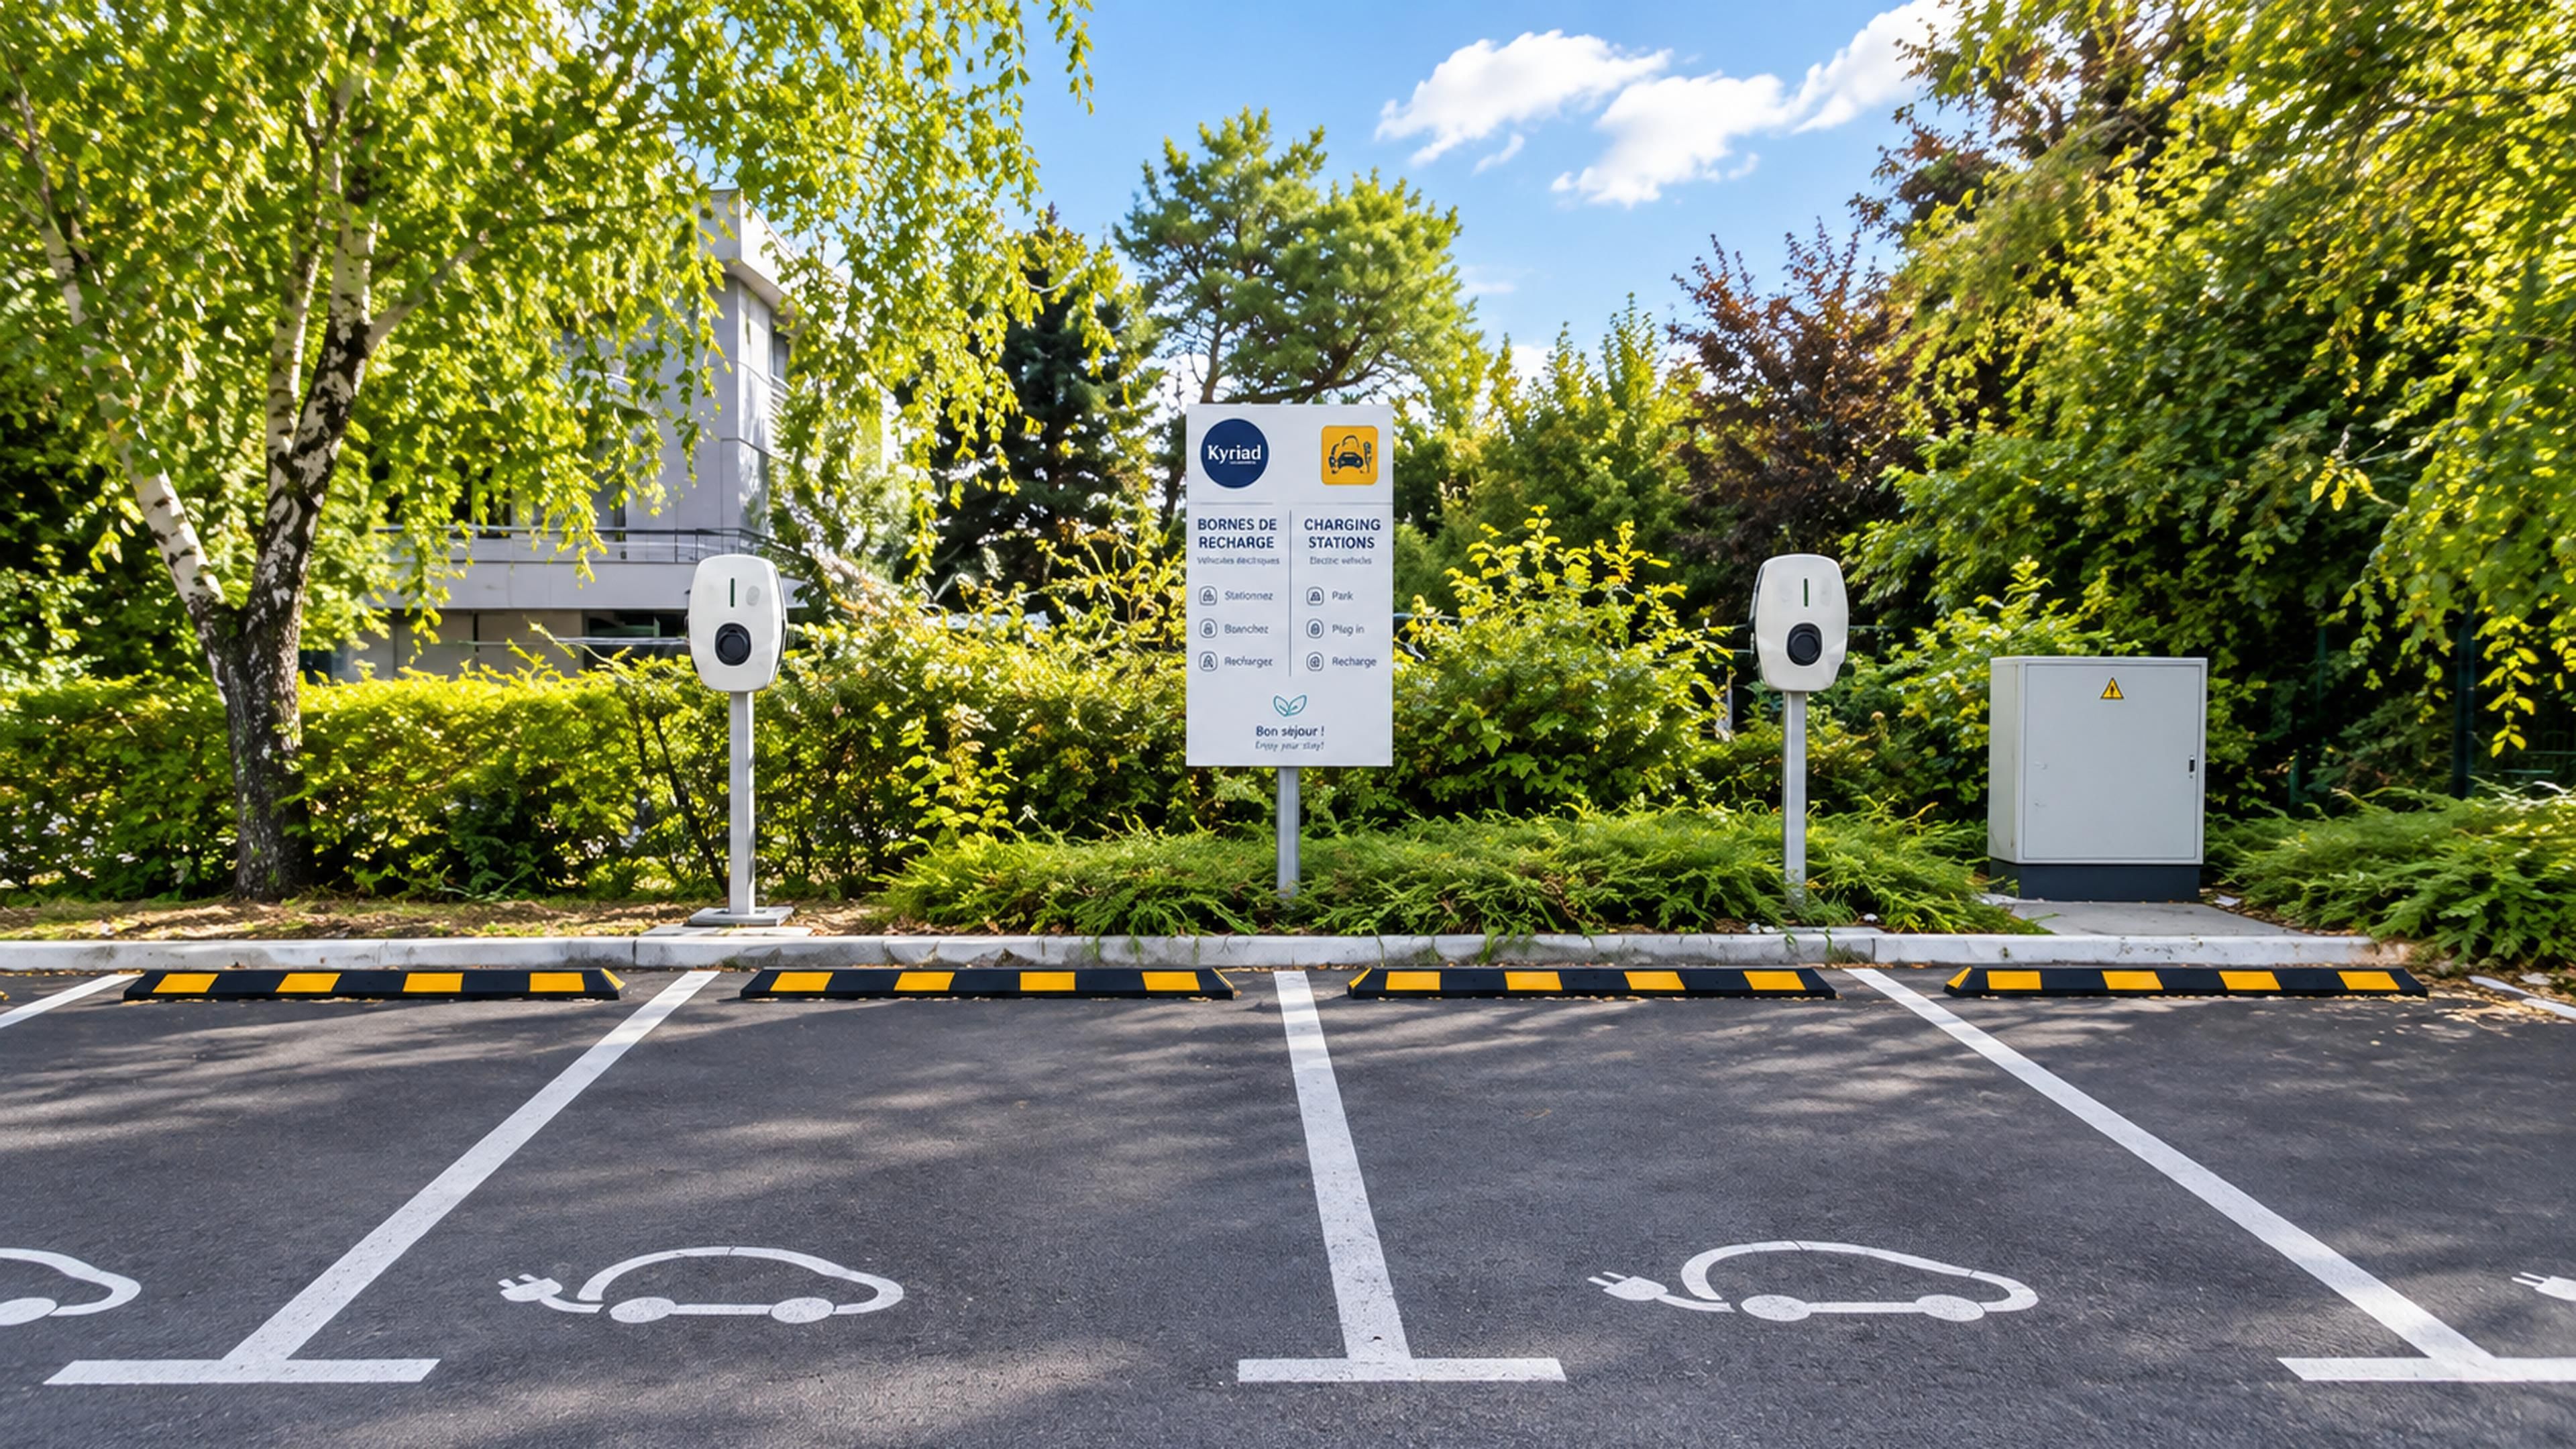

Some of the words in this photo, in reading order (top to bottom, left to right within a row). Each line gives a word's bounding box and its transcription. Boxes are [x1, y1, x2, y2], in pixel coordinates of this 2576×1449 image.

[1208, 444, 1261, 464] Kyriad
[1197, 518, 1255, 531] BORNES
[1258, 518, 1278, 531] DE
[1303, 518, 1381, 531] CHARGING
[1198, 536, 1275, 549] RECHARGE
[1308, 536, 1375, 549] STATIONS
[1224, 590, 1274, 601] Stationnez
[1332, 590, 1354, 601] Park
[1356, 624, 1365, 635] in
[1332, 655, 1377, 669] Recharge
[1256, 725, 1279, 737] Bon
[1281, 724, 1319, 740] séjour
[1320, 725, 1325, 737] !
